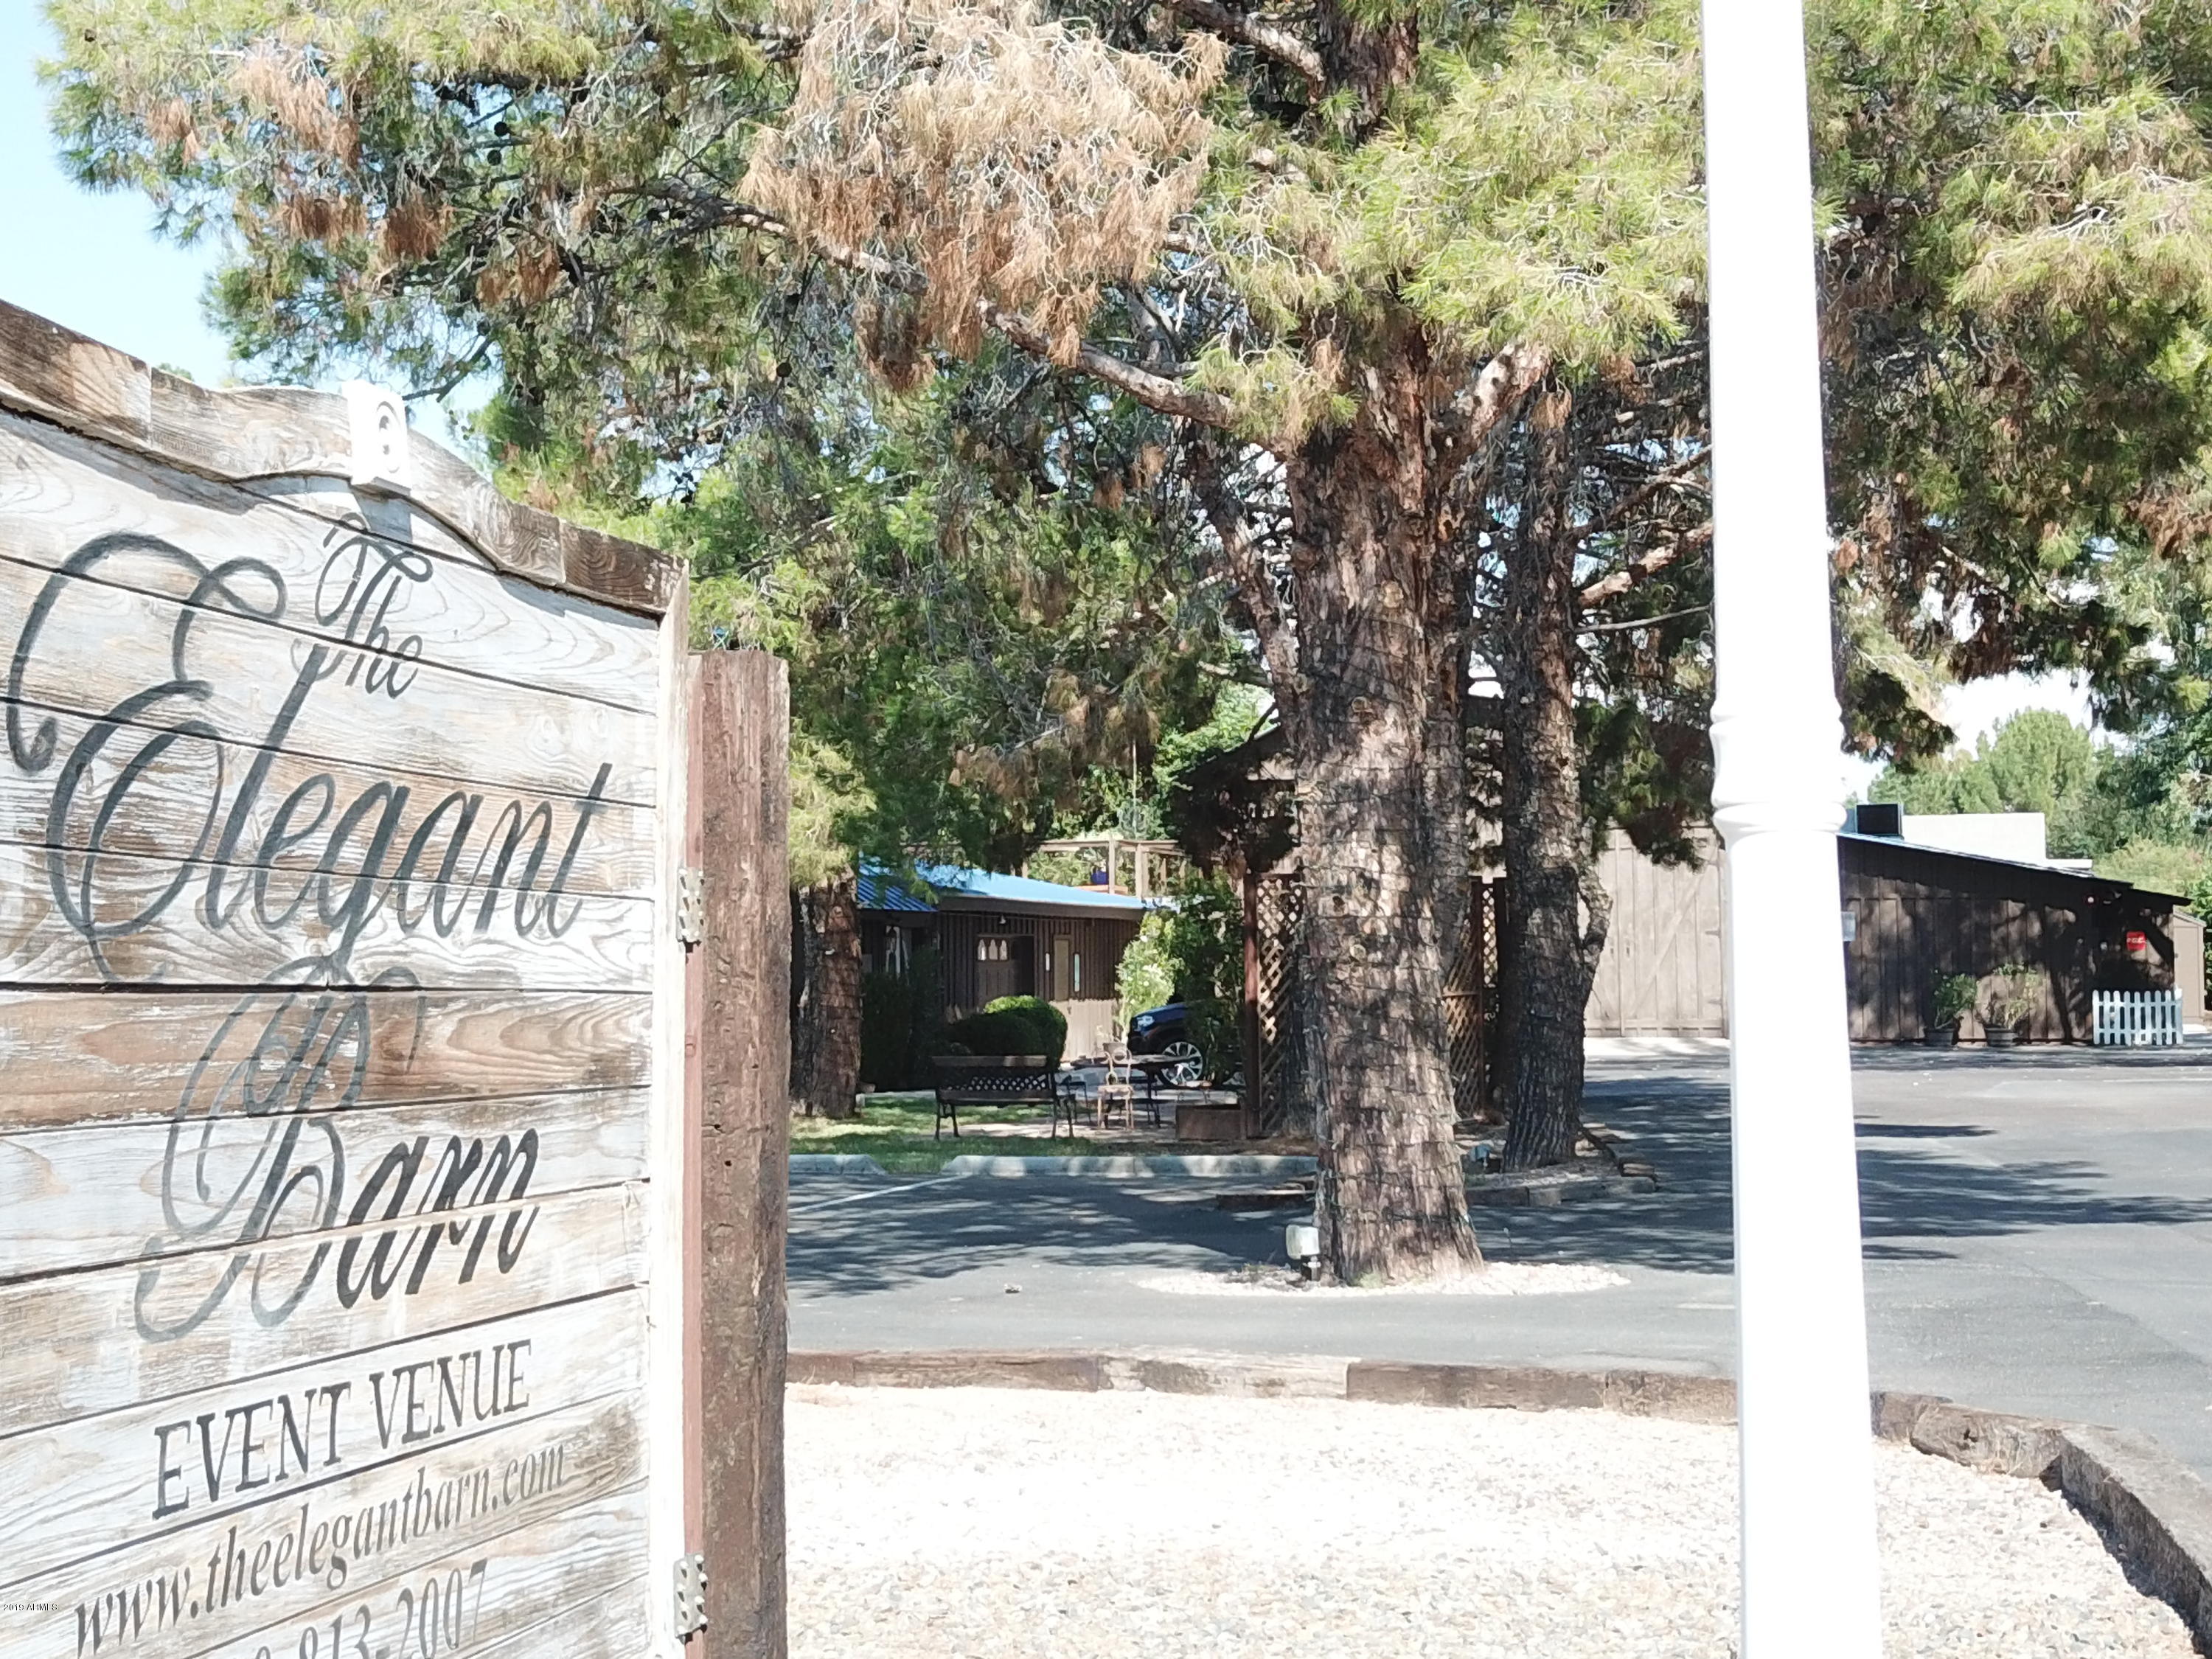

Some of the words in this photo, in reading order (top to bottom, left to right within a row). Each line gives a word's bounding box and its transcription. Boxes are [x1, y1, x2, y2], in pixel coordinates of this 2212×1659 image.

[291, 512, 433, 699] The
[6, 531, 613, 984] Elegant
[135, 959, 540, 1342] Barn
[152, 1381, 352, 1520] EVENT
[369, 1339, 532, 1449] VENUE
[74, 1443, 566, 1659] www.theelegantbarn.com
